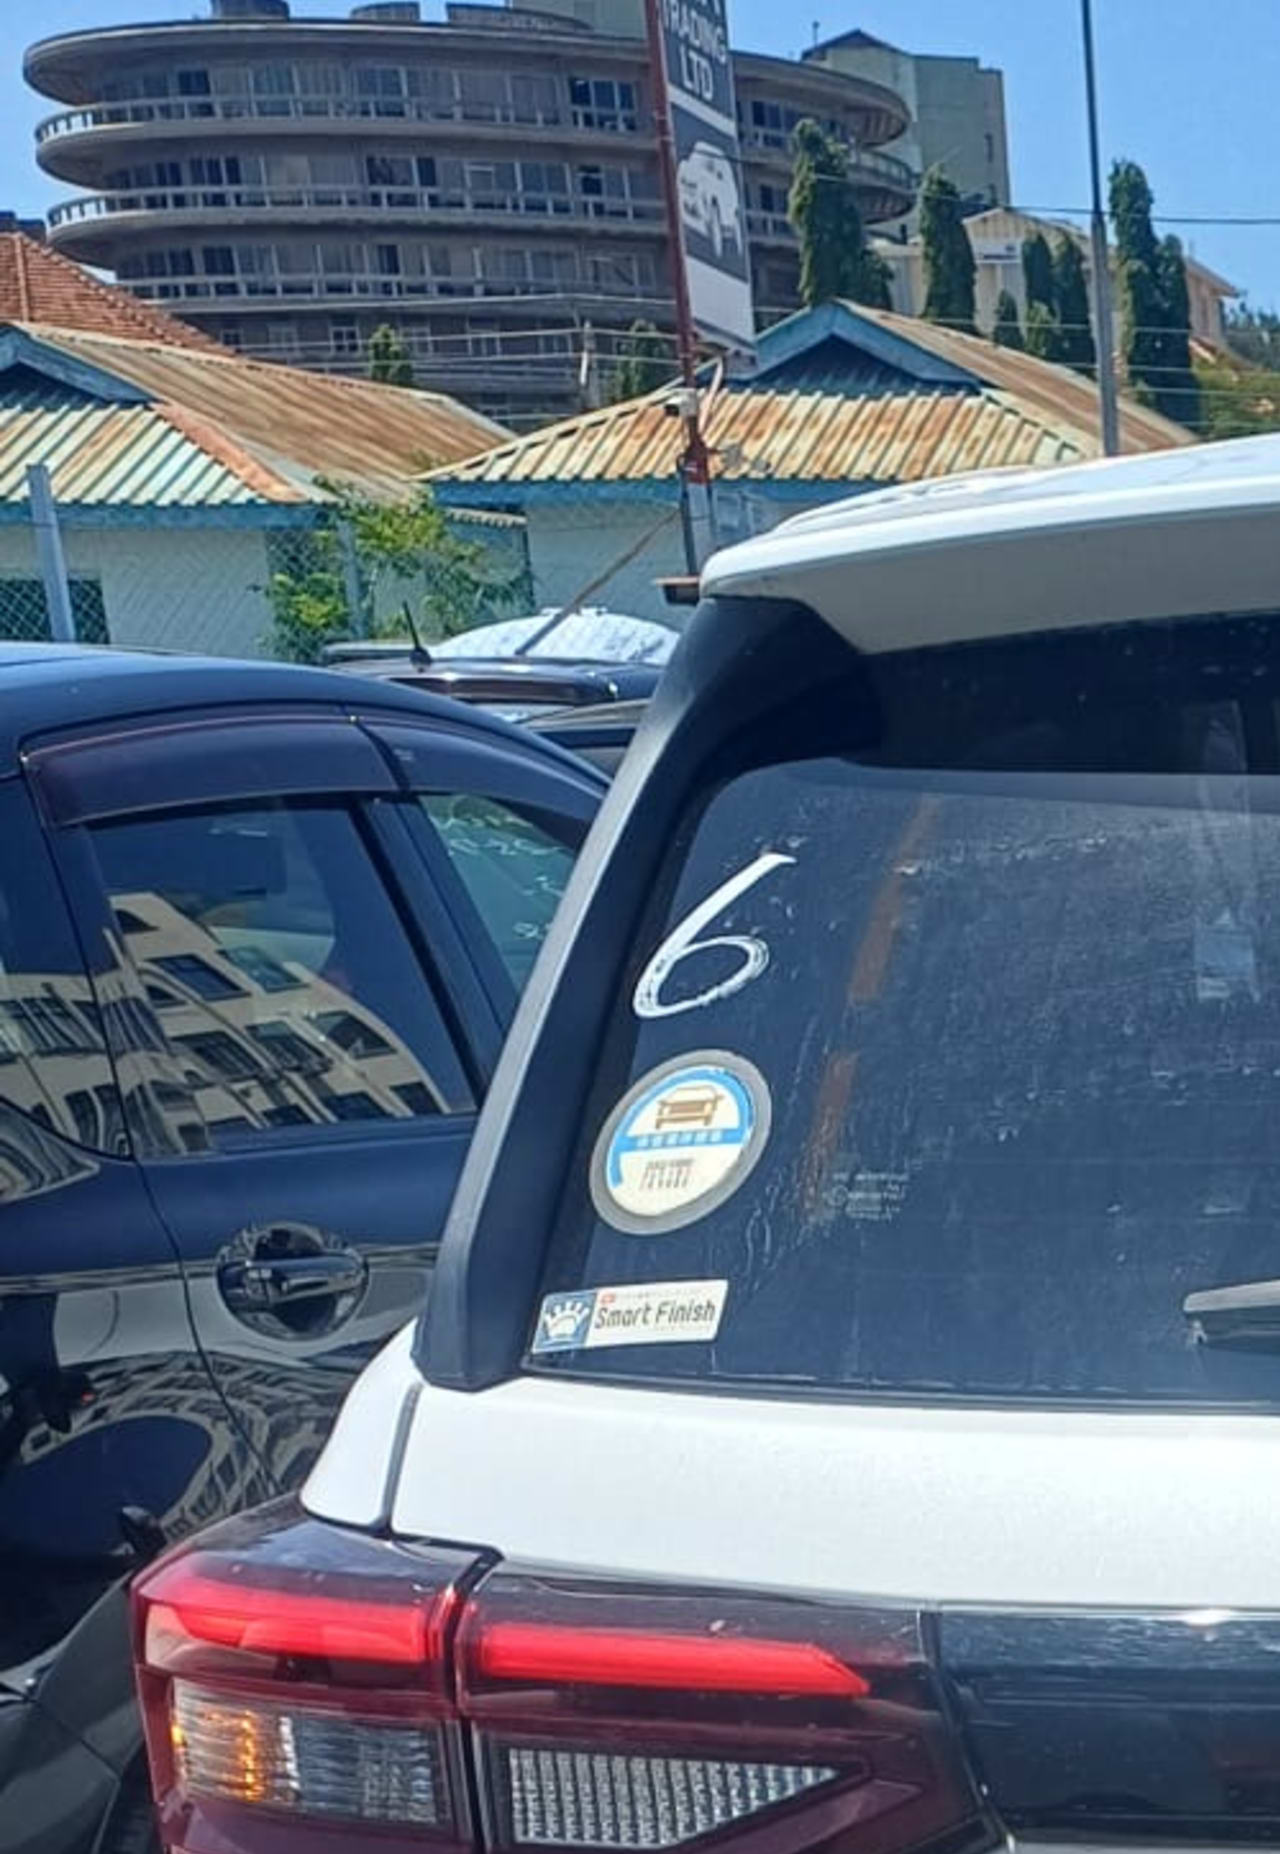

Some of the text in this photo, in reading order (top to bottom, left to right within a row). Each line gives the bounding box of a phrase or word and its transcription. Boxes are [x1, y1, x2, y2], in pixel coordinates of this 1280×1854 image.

[680, 44, 714, 101] LTD
[595, 1299, 716, 1328] Smart Finish
